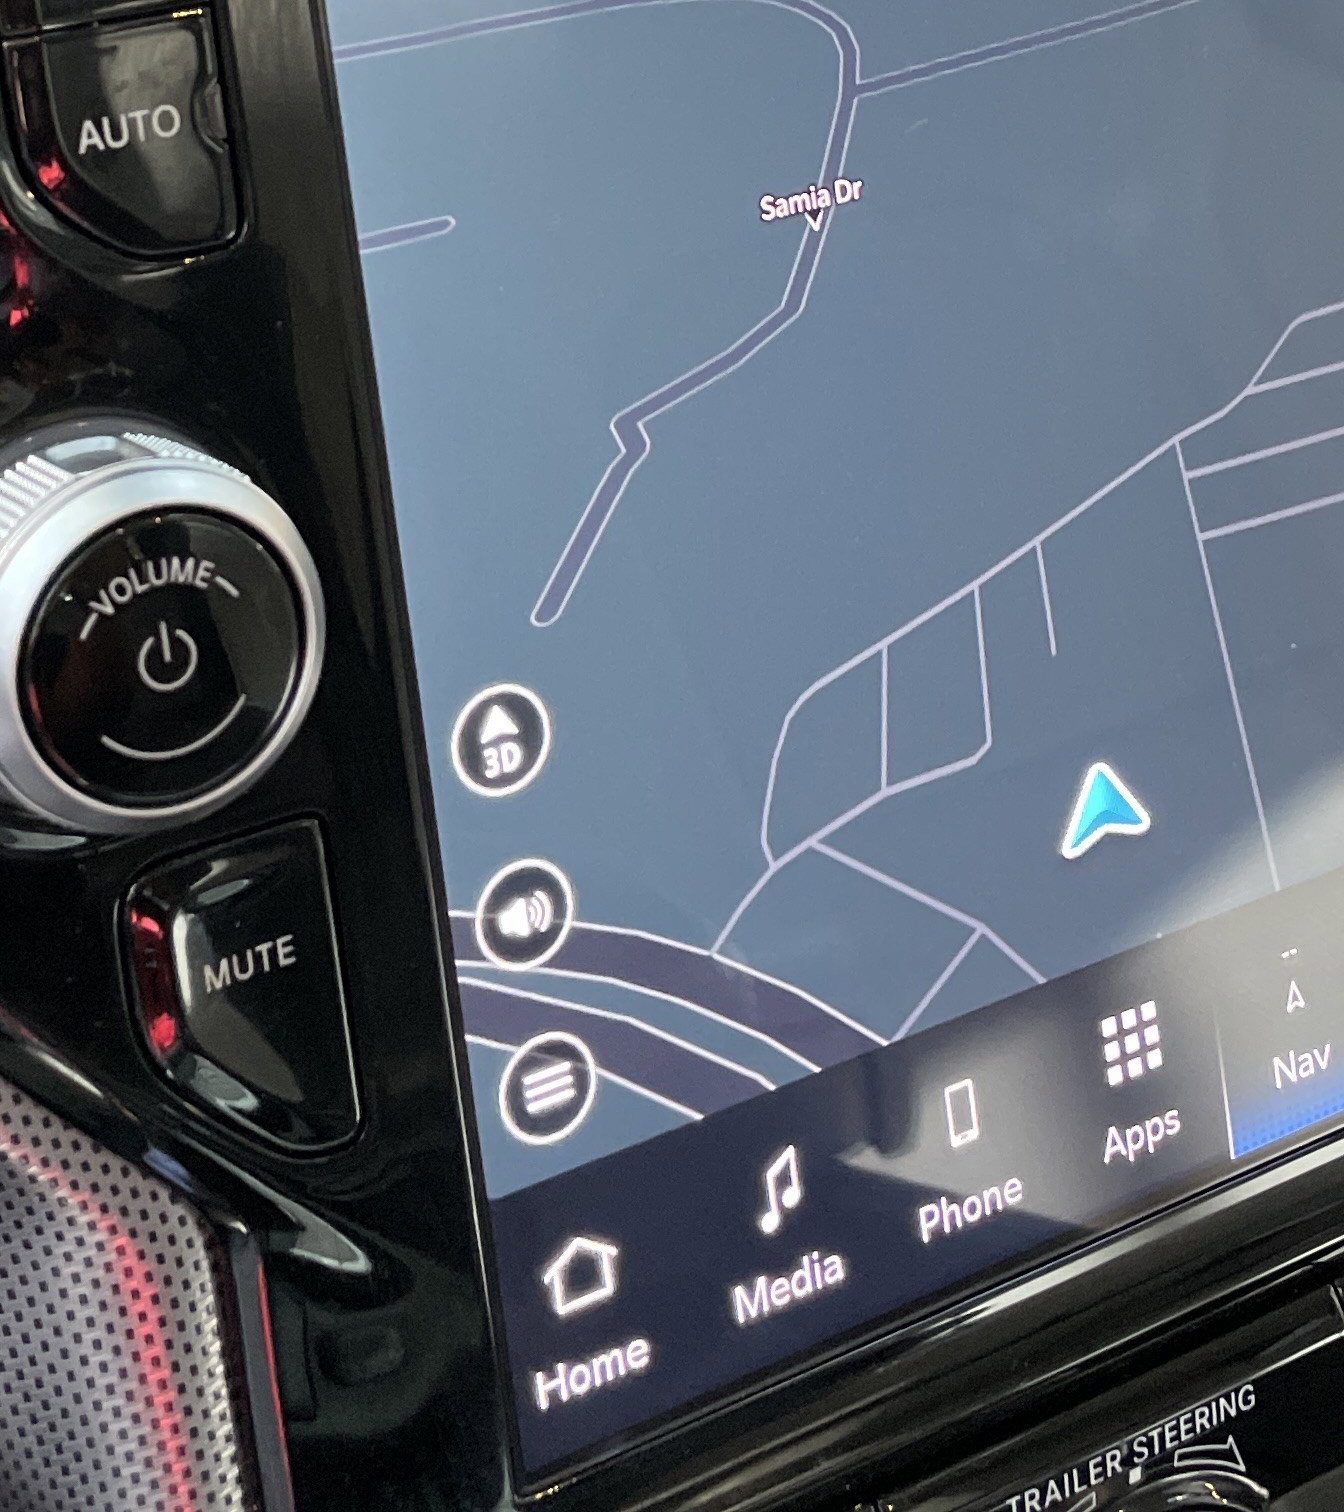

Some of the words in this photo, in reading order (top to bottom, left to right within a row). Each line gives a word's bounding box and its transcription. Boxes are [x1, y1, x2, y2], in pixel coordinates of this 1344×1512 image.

[79, 104, 181, 154] AUTO
[760, 186, 832, 222] Samia
[835, 178, 864, 206] Dr
[88, 555, 216, 616] VOLUME
[484, 741, 522, 778] 3D
[204, 934, 297, 994] MUTE
[1273, 1042, 1331, 1090] Nav
[1103, 1107, 1181, 1165] Apps
[919, 1176, 1023, 1244] Phone
[732, 1250, 846, 1324] Media
[534, 1338, 651, 1411] Home
[1006, 1449, 1122, 1512] TRAILER
[1132, 1383, 1256, 1464] STEERING
